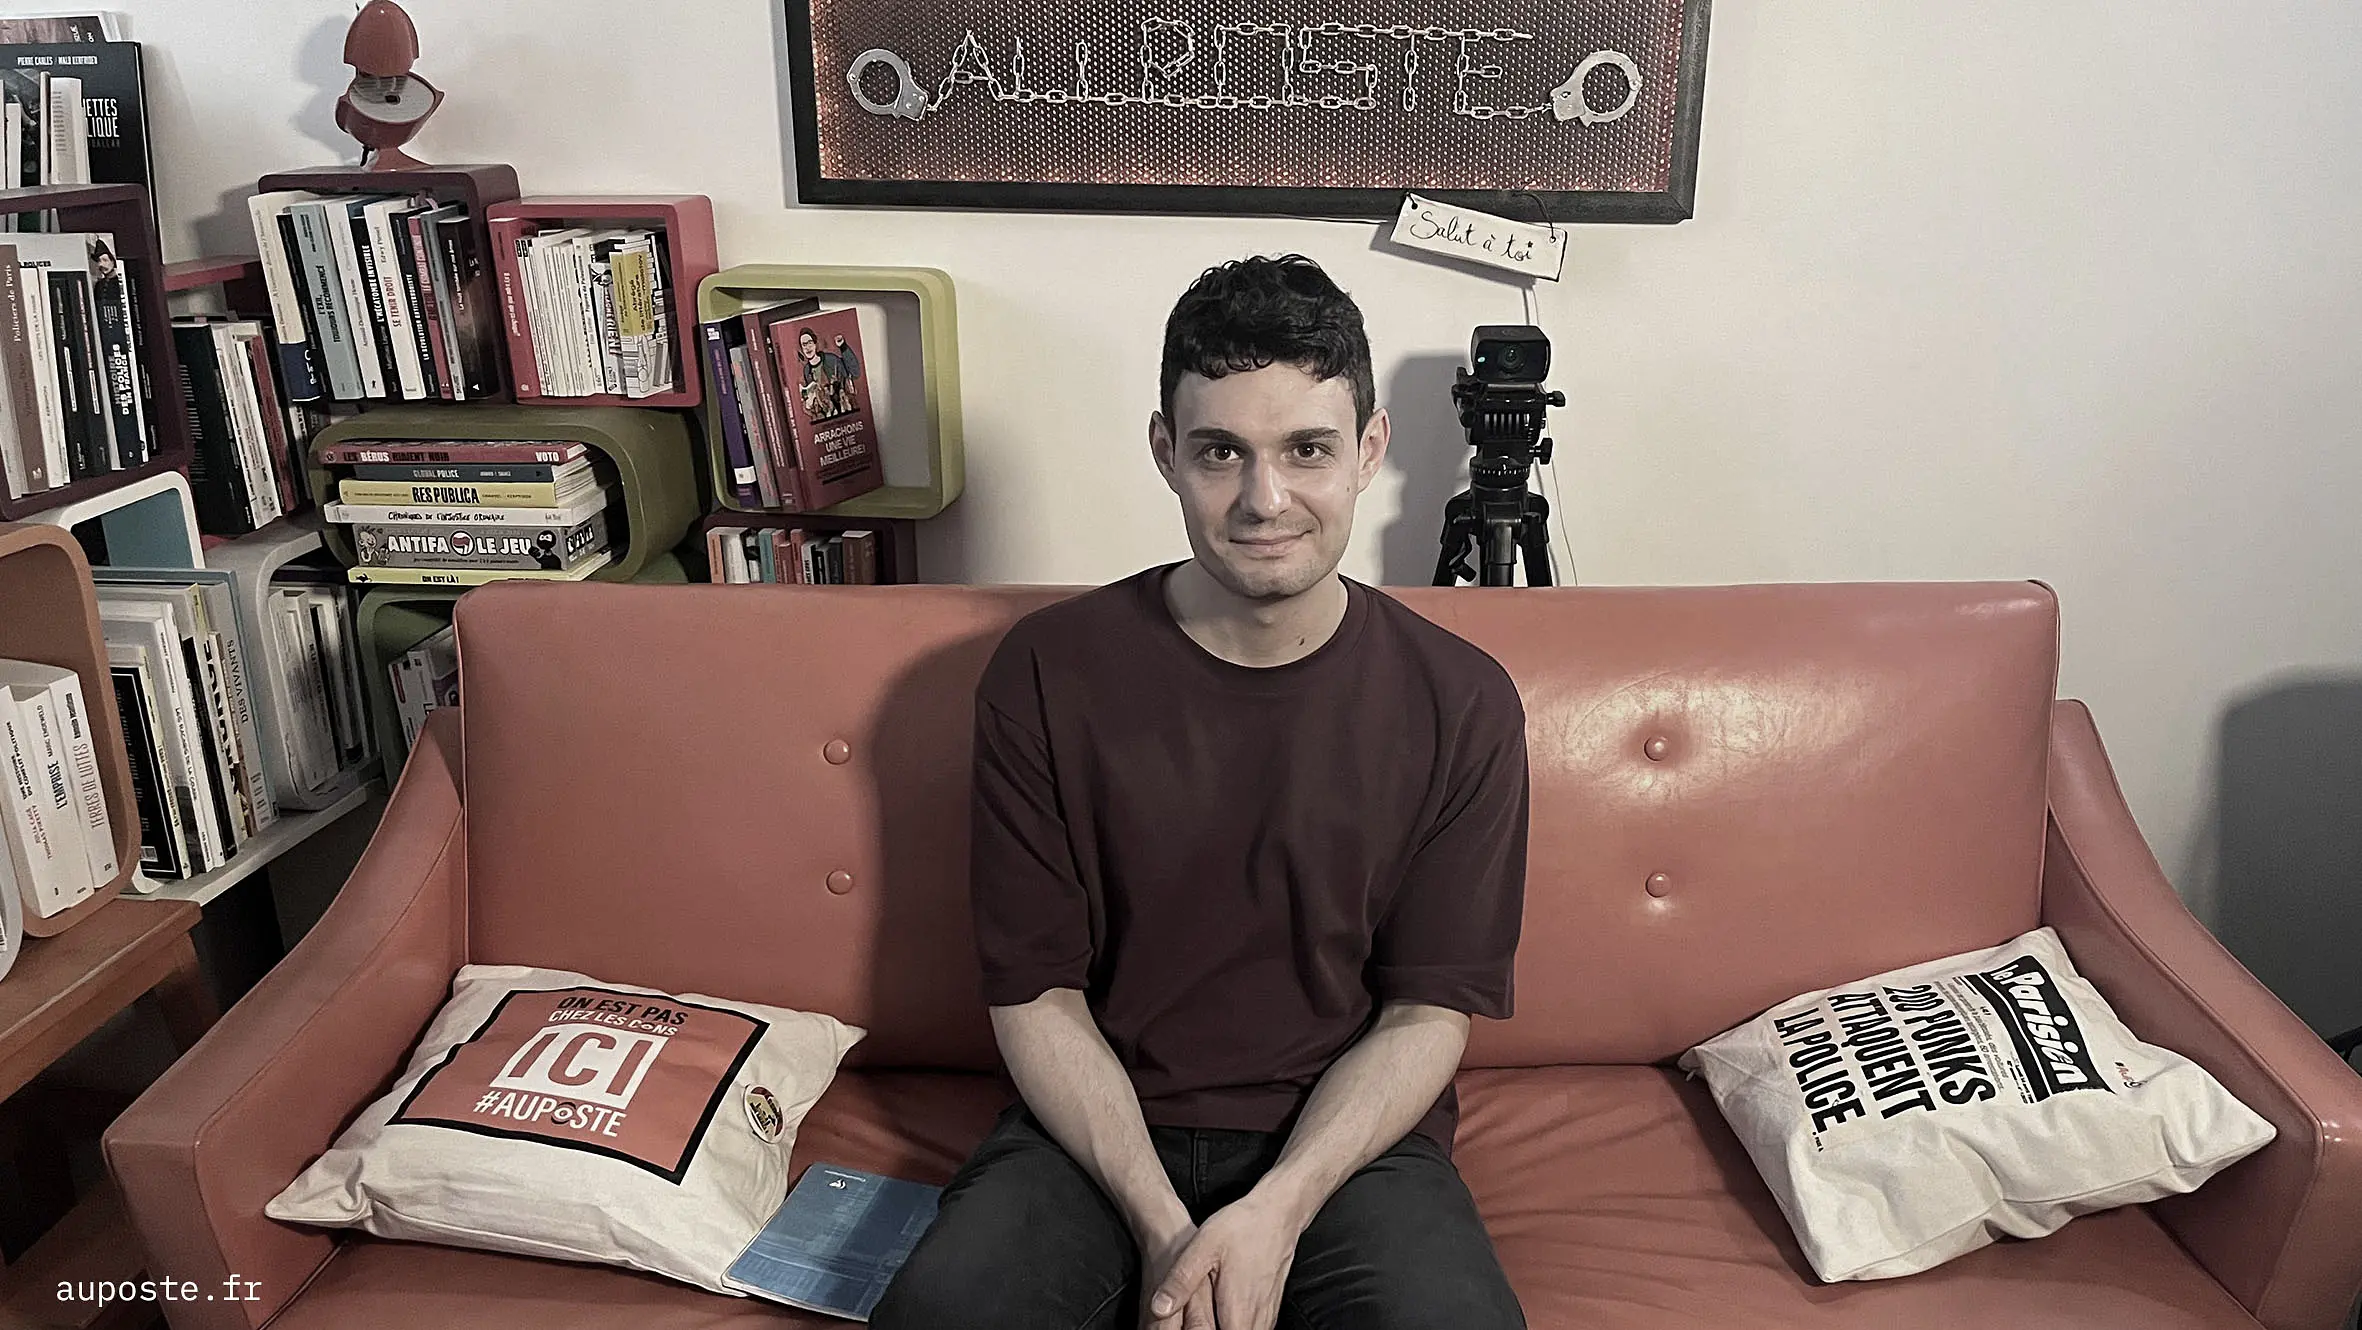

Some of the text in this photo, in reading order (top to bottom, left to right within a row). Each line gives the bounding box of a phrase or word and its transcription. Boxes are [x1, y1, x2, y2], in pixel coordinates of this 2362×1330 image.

[83, 98, 118, 116] ETTES
[1410, 210, 1534, 262] Salut à toi
[361, 244, 375, 277] INVISIBLE
[3, 264, 21, 342] Policiers de Paris
[383, 275, 401, 327] SE TENIR DROIT
[629, 279, 638, 311] Abrégé
[108, 354, 120, 403] HISTOIRE
[112, 343, 129, 414] DES POLICES
[121, 354, 132, 403] EN FRANCE
[814, 420, 864, 445] ARRACHONS
[825, 434, 856, 452] UNE VIE
[360, 450, 390, 462] BÉRUS
[536, 452, 560, 462] VOTO
[437, 470, 460, 478] POLICE
[412, 486, 432, 503] RES
[432, 487, 480, 504] PUBLICA
[388, 536, 532, 555] ANTIFA LE JEU
[226, 639, 248, 722] DES VIVANTS
[5, 720, 33, 795] DU CONFLIT POLITIQUE
[72, 742, 94, 778] LUTTES
[10, 754, 27, 799] UNE HISTOIRE
[47, 760, 68, 809] L'EMPRISE
[80, 777, 97, 792] DE
[31, 804, 44, 831] PIKETTY
[83, 792, 105, 828] TERRES
[30, 825, 40, 843] JULIA
[556, 996, 689, 1026] ON EST PAS
[1882, 984, 1945, 1012] 200
[548, 1010, 594, 1022] CHEZ
[594, 1012, 627, 1026] LES
[2007, 970, 2089, 1085] Parisien
[507, 1031, 654, 1096] ICI
[1773, 1007, 1866, 1134] LA POLICE
[1826, 992, 1937, 1120] ATTAQUENT
[1902, 1009, 1996, 1105] PUNKS
[472, 1090, 628, 1138] #AUPOSTE
